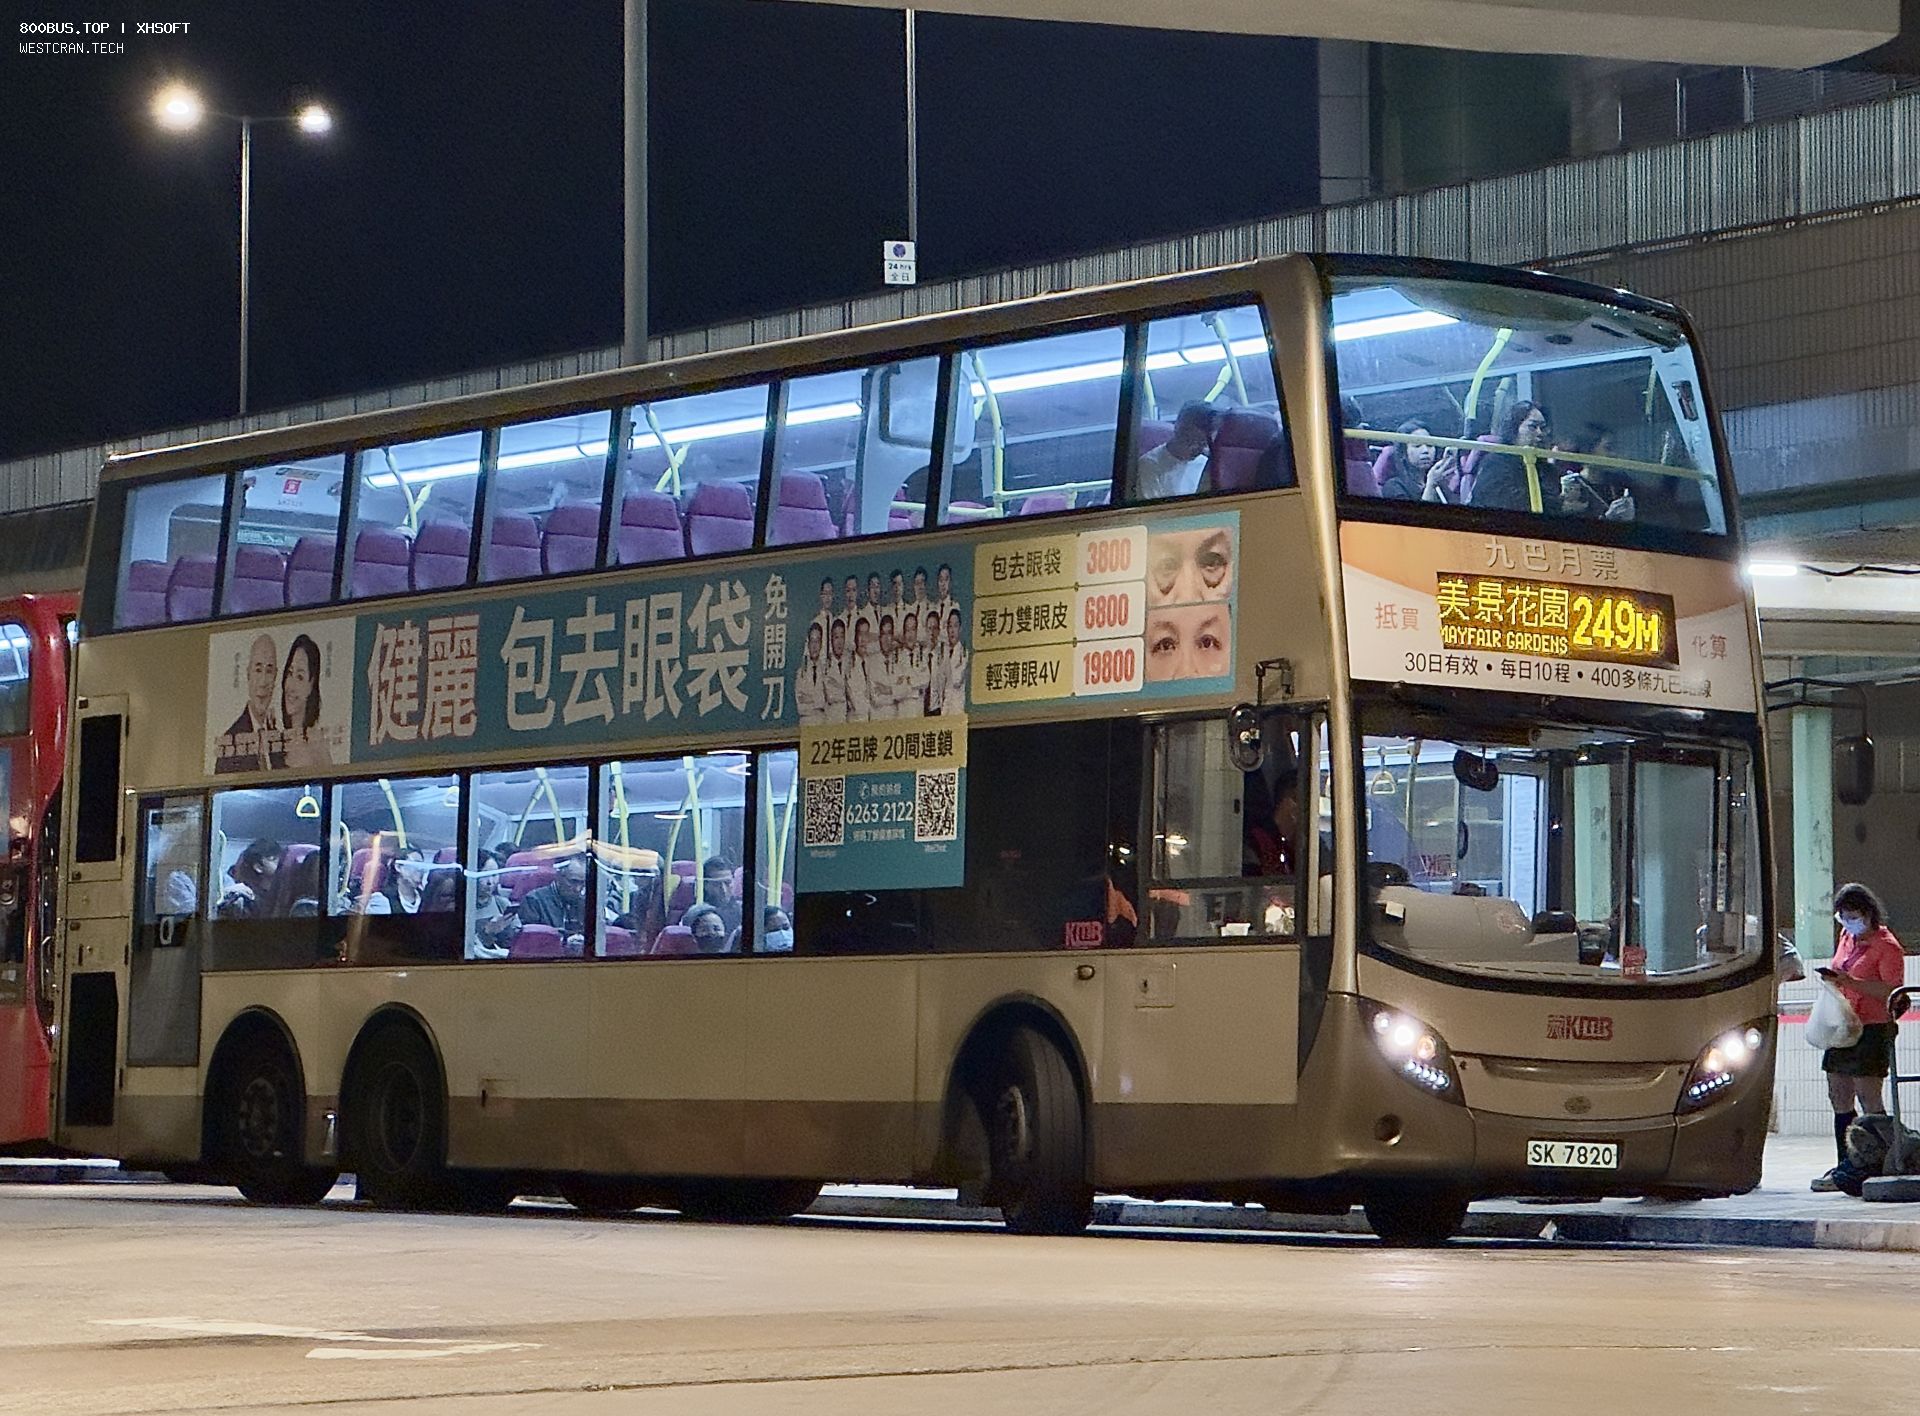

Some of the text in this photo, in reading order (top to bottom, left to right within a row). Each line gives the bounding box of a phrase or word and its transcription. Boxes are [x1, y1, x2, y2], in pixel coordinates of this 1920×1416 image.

[992, 548, 1061, 582] 包去眼袋
[1087, 538, 1131, 574] 3800
[1485, 537, 1618, 580] 九巴月票
[980, 601, 1068, 637] 彈力雙眼皮
[1084, 593, 1129, 630] 6800
[1375, 601, 1420, 631] 抵買
[1437, 578, 1570, 630] 美景花園
[1440, 624, 1568, 654] MAYFAIR GARDENS
[1573, 596, 1660, 652] 249M
[368, 579, 750, 746] 健麗 包去眼袋
[760, 572, 788, 720] 免開刀
[986, 660, 1060, 691] 輕薄眼4V
[1083, 648, 1135, 685] 19800
[1405, 652, 1479, 676] 30日有效
[1501, 658, 1571, 683] 每日10程
[811, 729, 953, 765] 22年品牌 20間連鎖
[846, 801, 914, 824] 6263 2122
[1531, 1144, 1612, 1166] SK 7820
